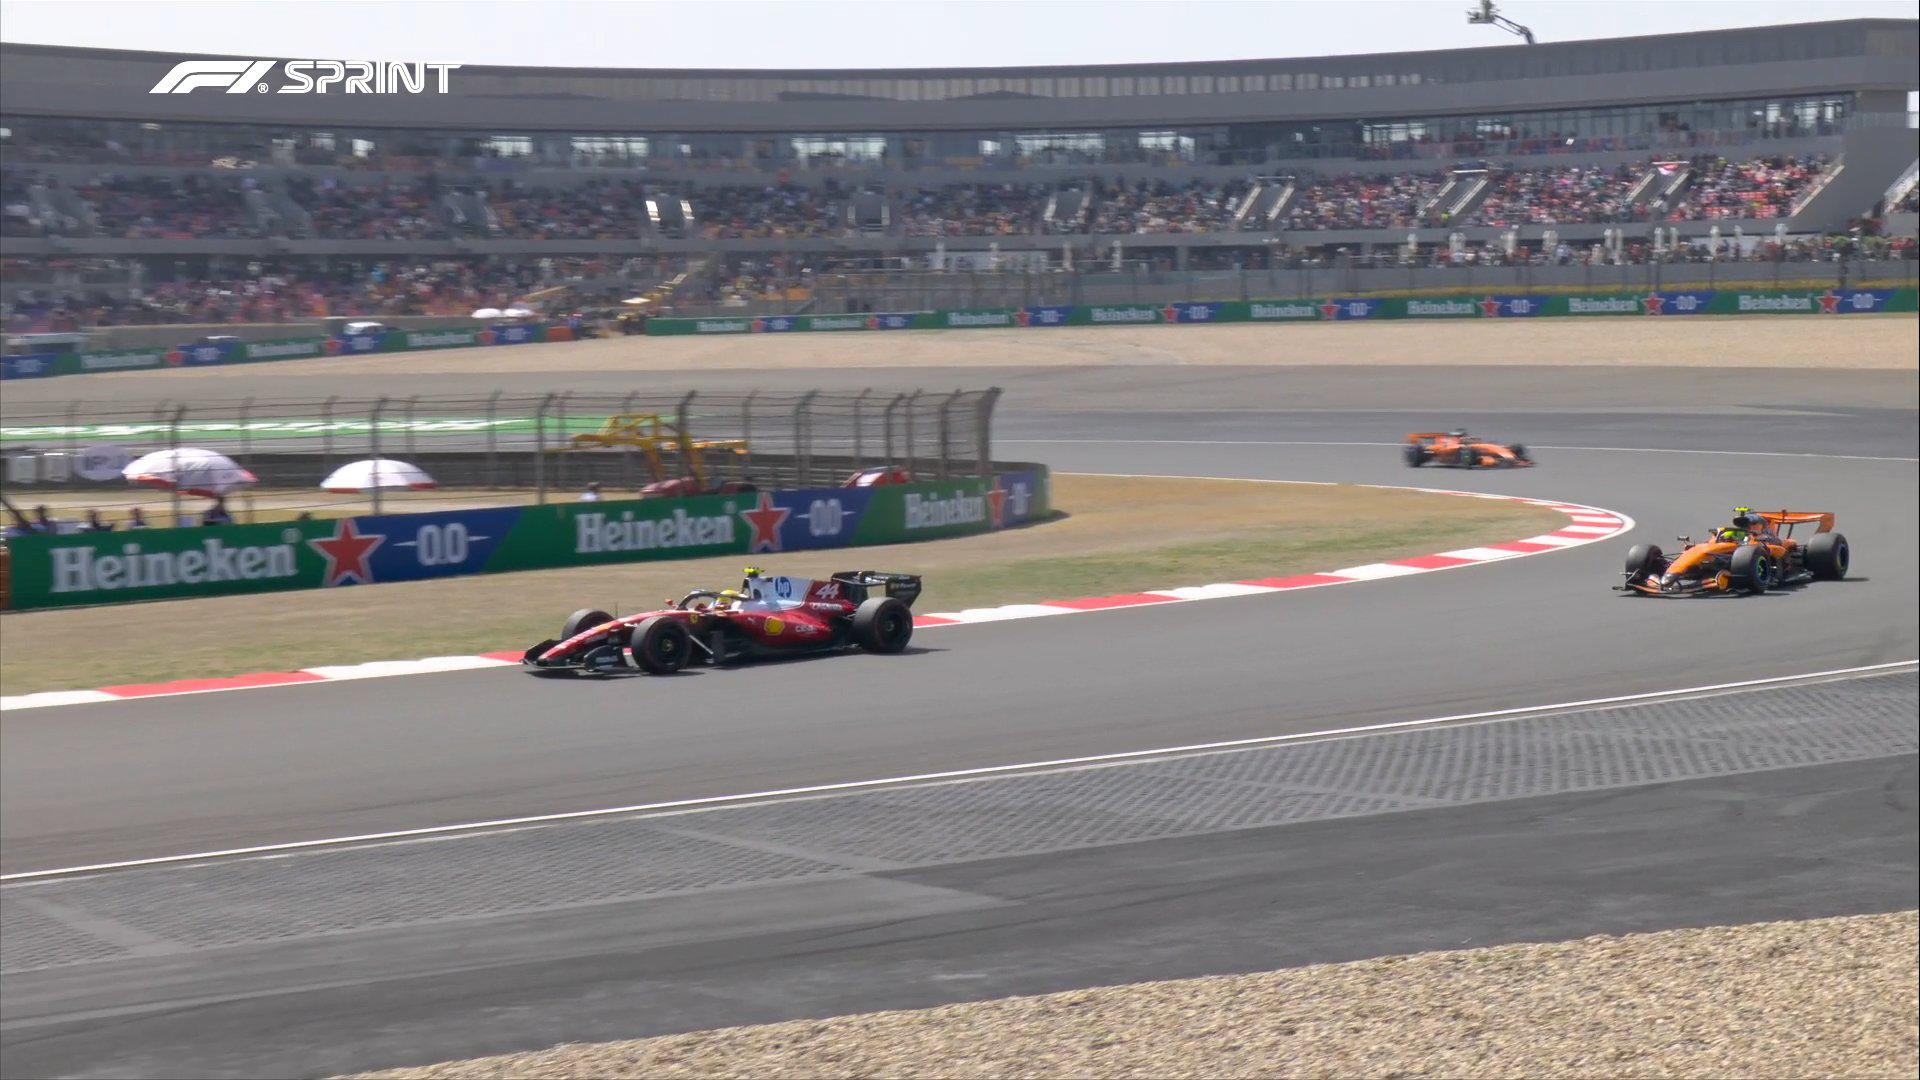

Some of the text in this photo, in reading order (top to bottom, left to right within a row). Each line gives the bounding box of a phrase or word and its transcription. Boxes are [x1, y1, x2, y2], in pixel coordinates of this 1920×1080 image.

[1738, 294, 1813, 310] Heineken
[904, 489, 985, 529] Heineken
[575, 507, 735, 553] Heineken
[50, 536, 299, 593] Heineken
[775, 577, 792, 598] hp
[816, 583, 840, 599] 44
